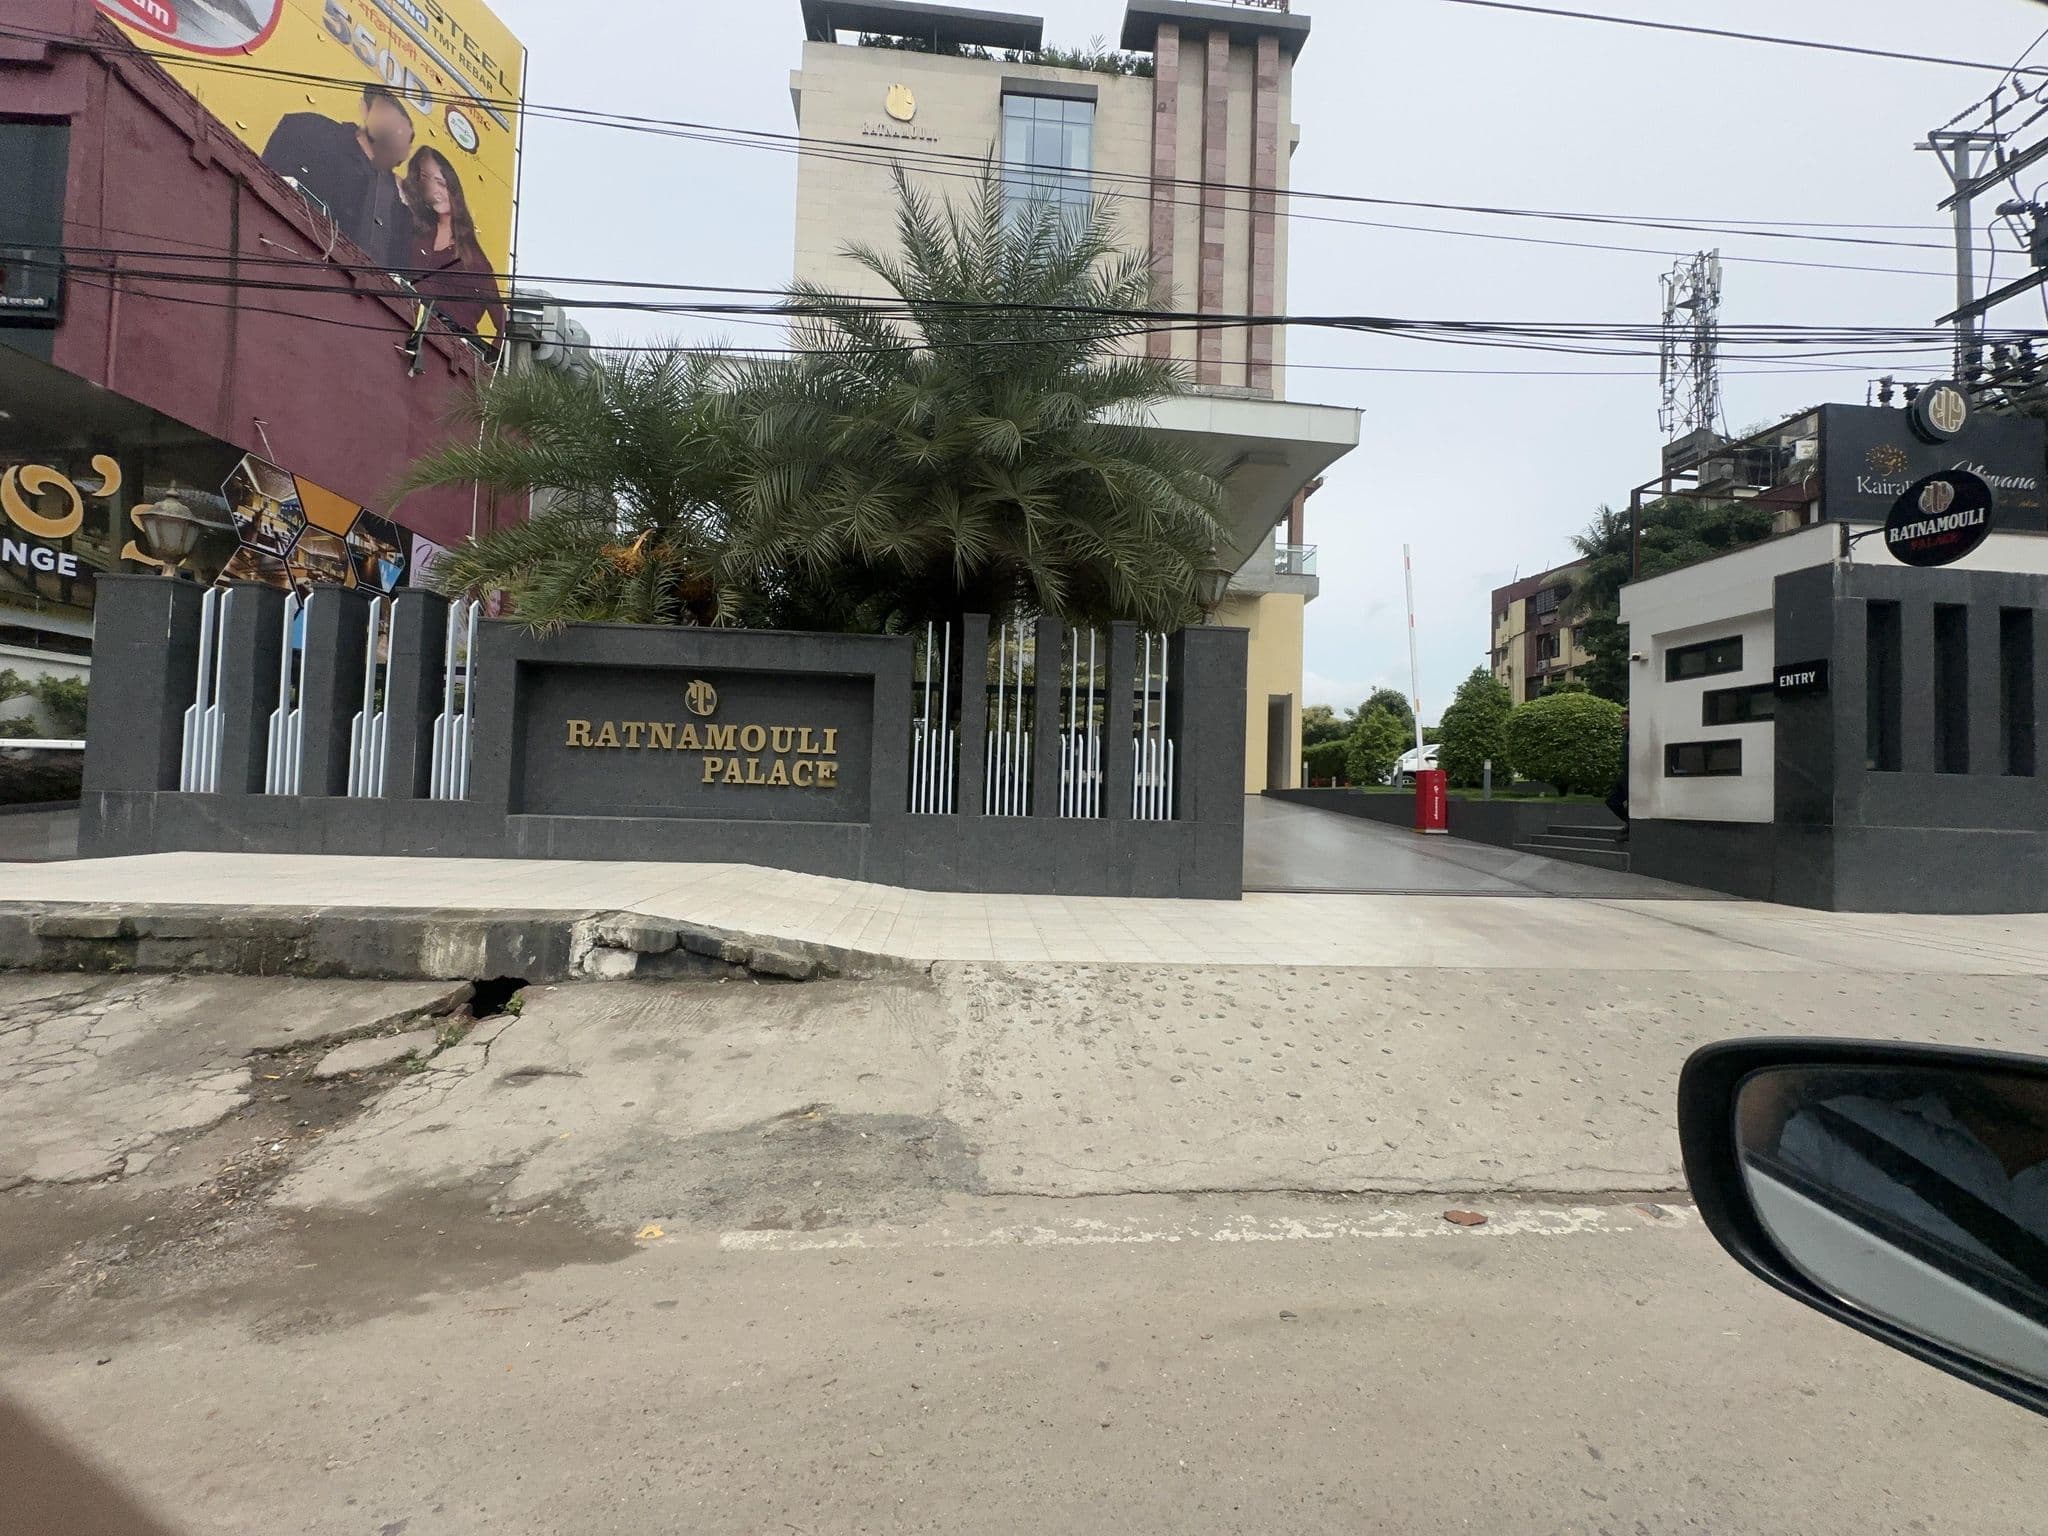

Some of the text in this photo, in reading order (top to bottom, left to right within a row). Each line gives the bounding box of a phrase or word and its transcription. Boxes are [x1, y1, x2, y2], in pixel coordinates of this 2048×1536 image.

[323, 0, 433, 115] 550D
[424, 0, 513, 96] STEEL
[431, 25, 457, 56] TMT
[459, 53, 493, 93] REBAR
[1857, 475, 1914, 496] Kairal
[1889, 508, 1985, 543] RATNAMOULI
[1780, 671, 1816, 687] ENTRY
[565, 719, 838, 755] RATNAMOULI
[702, 756, 839, 788] PALACE
